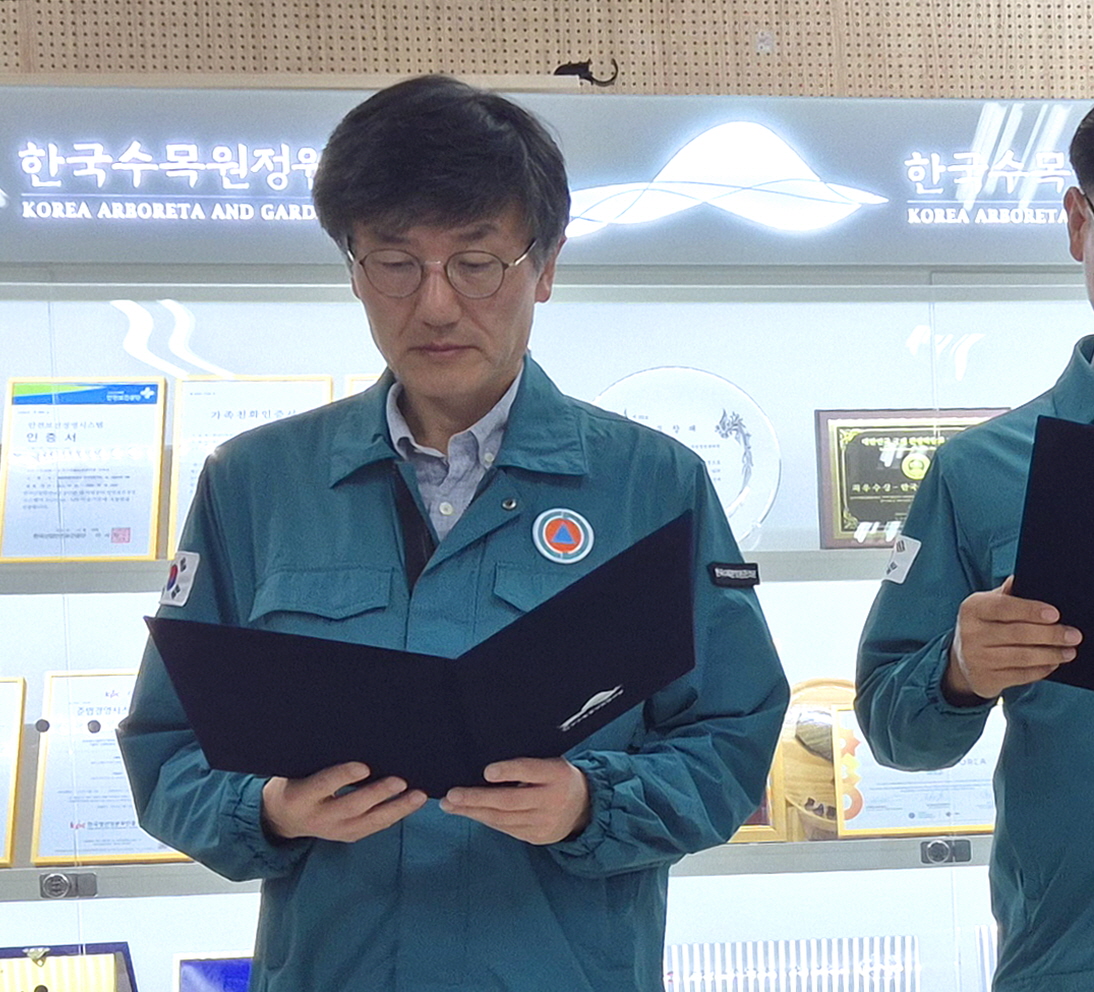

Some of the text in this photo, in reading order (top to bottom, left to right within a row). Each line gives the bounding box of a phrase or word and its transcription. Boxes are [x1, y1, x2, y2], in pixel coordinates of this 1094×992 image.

[904, 150, 1072, 194] 한국수목
[22, 201, 318, 221] KOREA ARBORETA AND GARD
[907, 208, 1069, 225] KOREA ARBORETA
